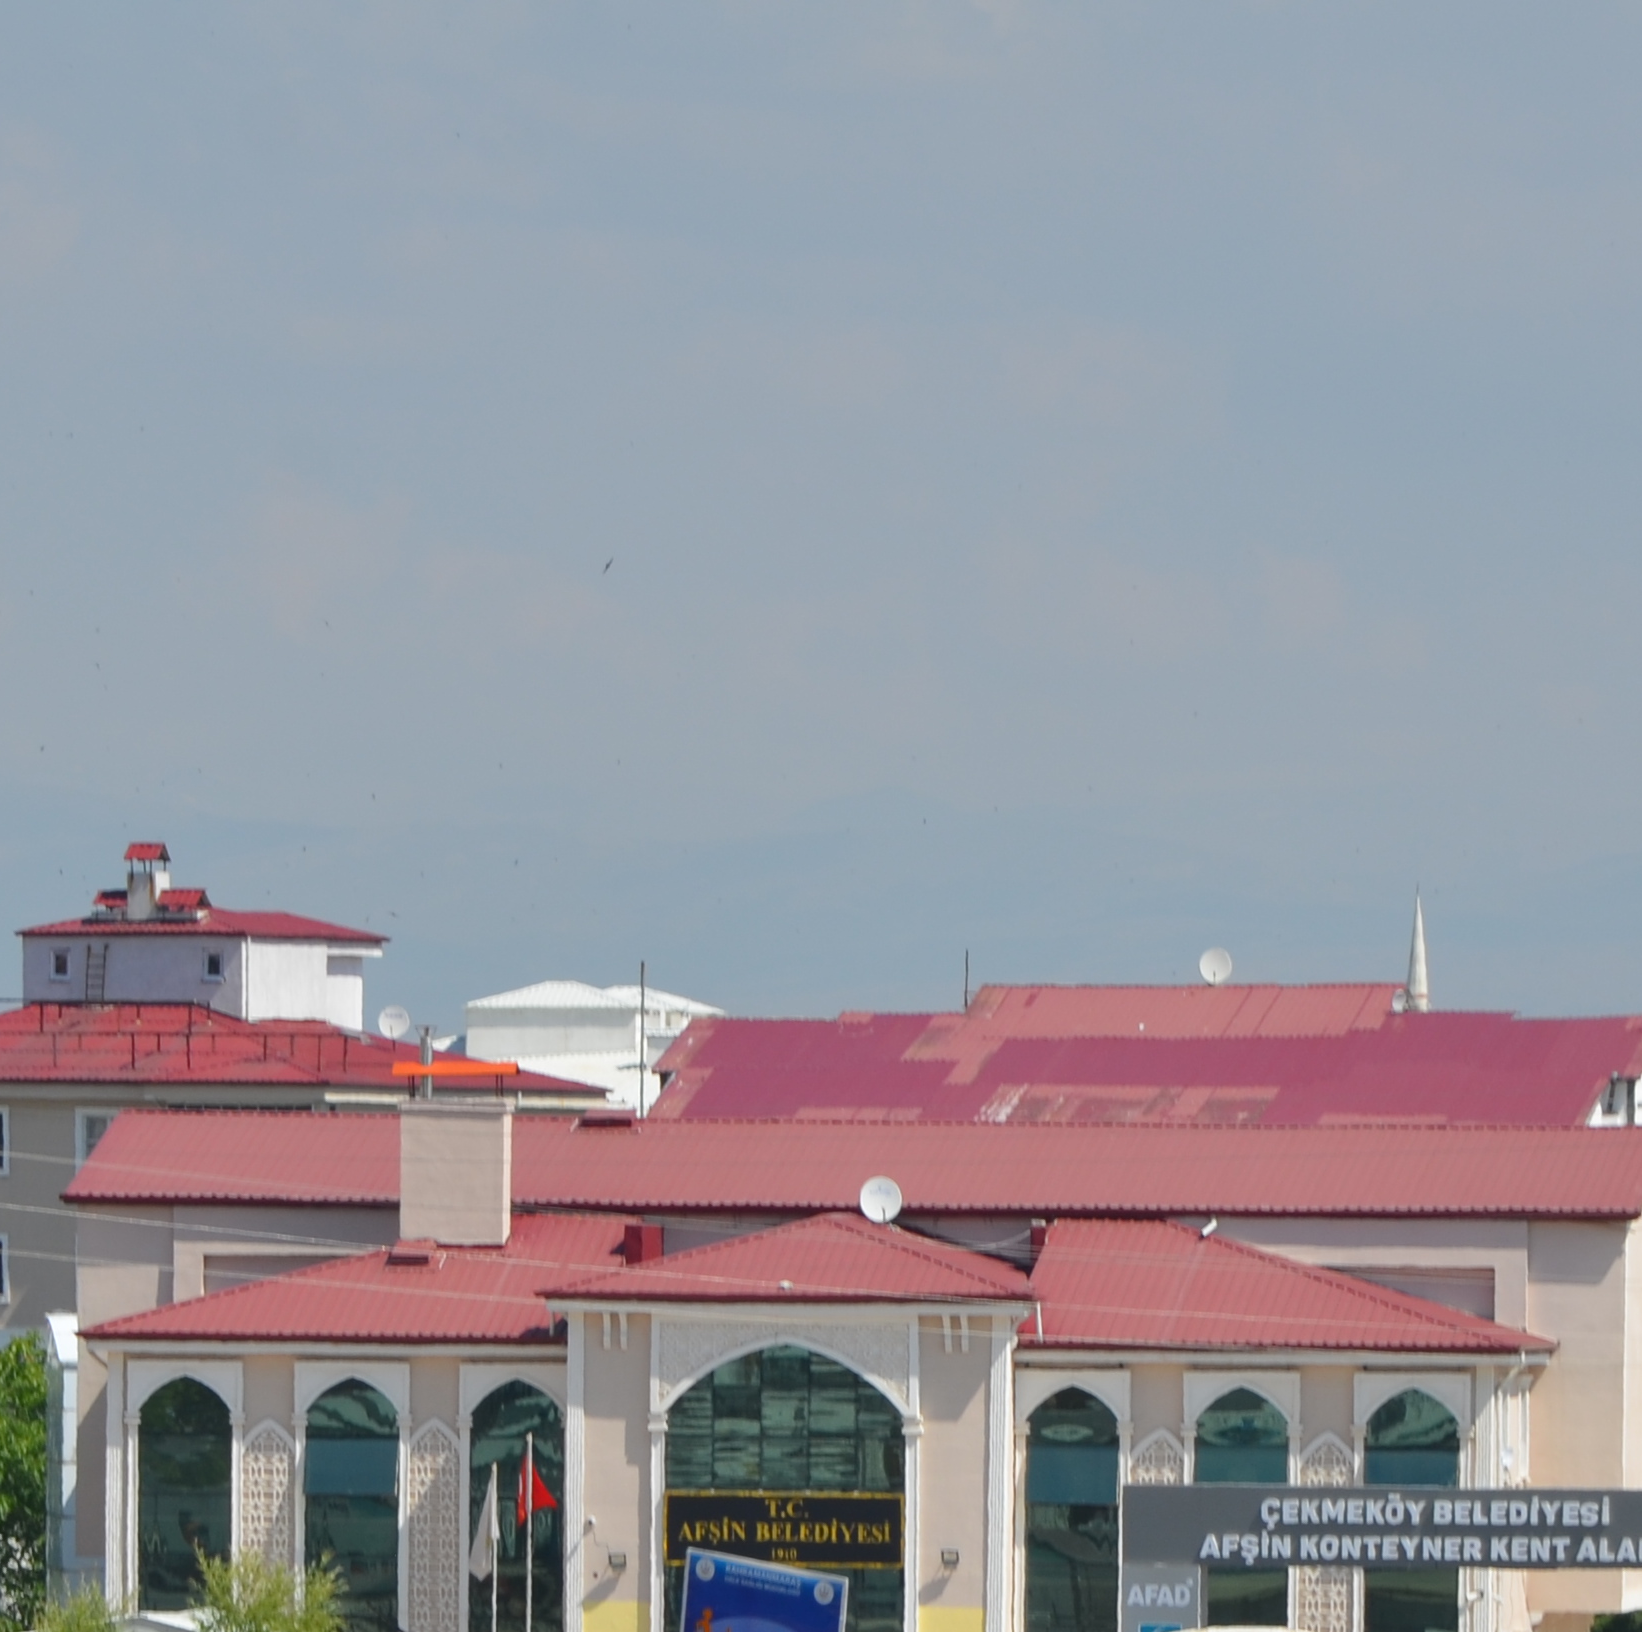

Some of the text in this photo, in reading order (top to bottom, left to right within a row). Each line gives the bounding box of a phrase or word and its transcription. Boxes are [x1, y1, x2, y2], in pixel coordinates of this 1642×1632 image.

[1260, 1492, 1611, 1531] ÇEKMEKÖY BELEDİYESİ
[679, 1516, 892, 1545] AFŞİN BELEDİYESİ
[1200, 1528, 1291, 1566] AFŞİN
[1300, 1533, 1482, 1562] KONTEYNER
[1490, 1536, 1570, 1563] KENT
[1127, 1583, 1191, 1607] AFAD
